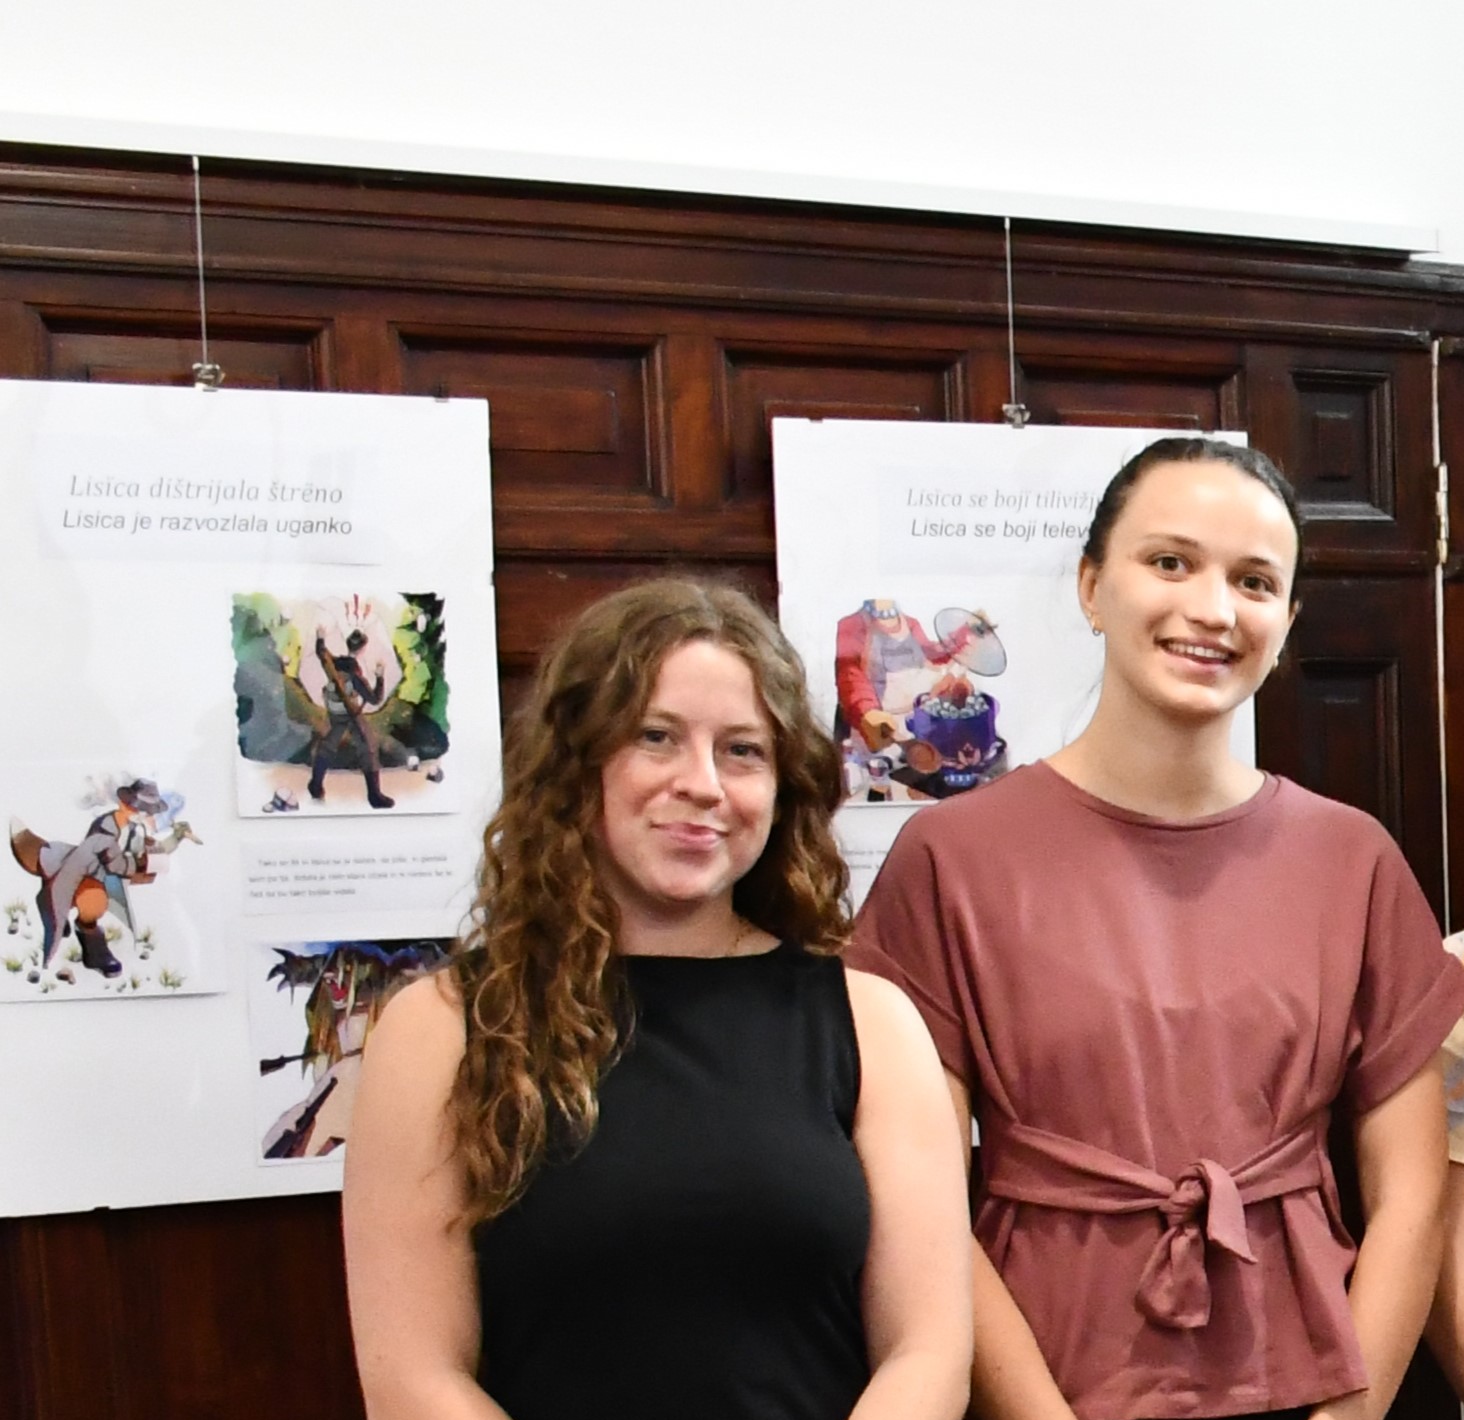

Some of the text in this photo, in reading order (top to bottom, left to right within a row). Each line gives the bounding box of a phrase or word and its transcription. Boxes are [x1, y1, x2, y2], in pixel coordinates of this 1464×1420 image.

[967, 493, 989, 509] se
[62, 509, 353, 538] Lisica je razvozlala uganko
[910, 518, 1090, 543] Lisica se boji telev
